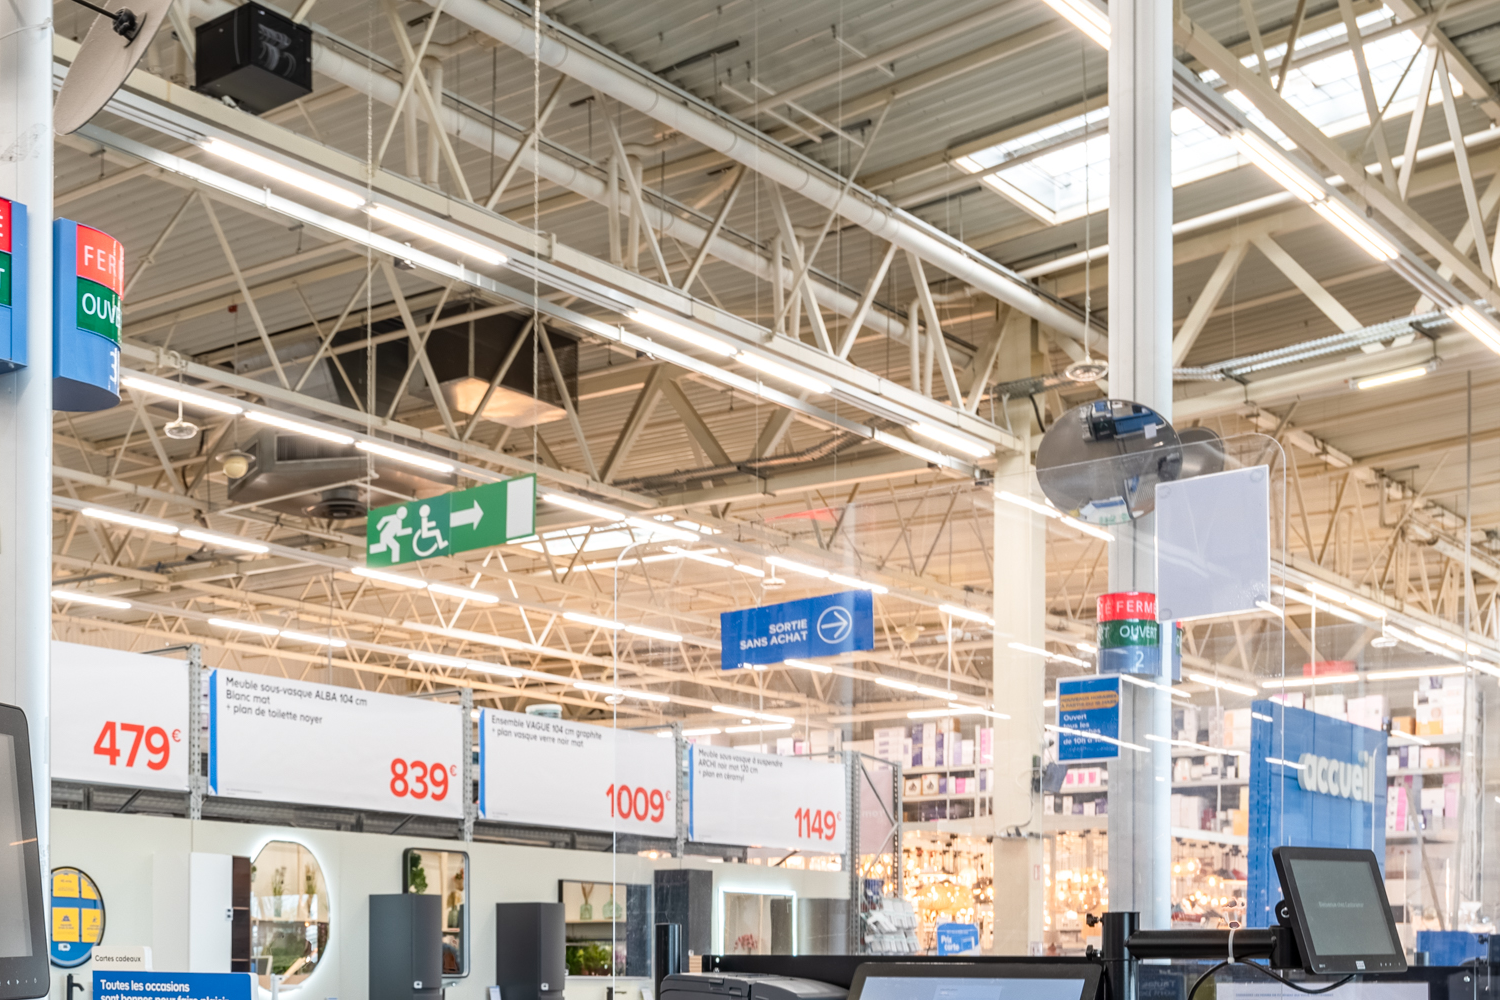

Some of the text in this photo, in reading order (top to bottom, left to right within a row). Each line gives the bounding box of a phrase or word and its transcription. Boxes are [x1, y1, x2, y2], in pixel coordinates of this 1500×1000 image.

[768, 618, 808, 635] SORTIE
[1119, 625, 1158, 639] OUVERT
[740, 630, 808, 651] SANS ACHAT
[1135, 650, 1145, 668] 2
[225, 676, 368, 706] Meuble sous-vasque ALBA 104 cm
[225, 689, 271, 705] Blanc mat
[233, 704, 253, 715] plan
[254, 707, 266, 717] de
[268, 708, 298, 721] toilette
[299, 714, 323, 726] noyer
[1063, 713, 1087, 722] Ouvert
[491, 714, 524, 729] Ensemble
[525, 720, 551, 732] VAGUE
[552, 724, 564, 734] 104
[576, 729, 602, 740] graphite
[496, 727, 584, 748] plan vasque verre noir mat
[698, 749, 718, 759] Meuble
[719, 753, 751, 764] sous-vasque
[757, 759, 783, 769] suspendre
[698, 759, 716, 768] ARCHI
[1298, 750, 1375, 803] accueil
[940, 934, 952, 944] Prix
[944, 941, 960, 951] carte
[94, 954, 142, 963] Cartes cadeaux
[100, 979, 190, 992] Toutes les occasions
